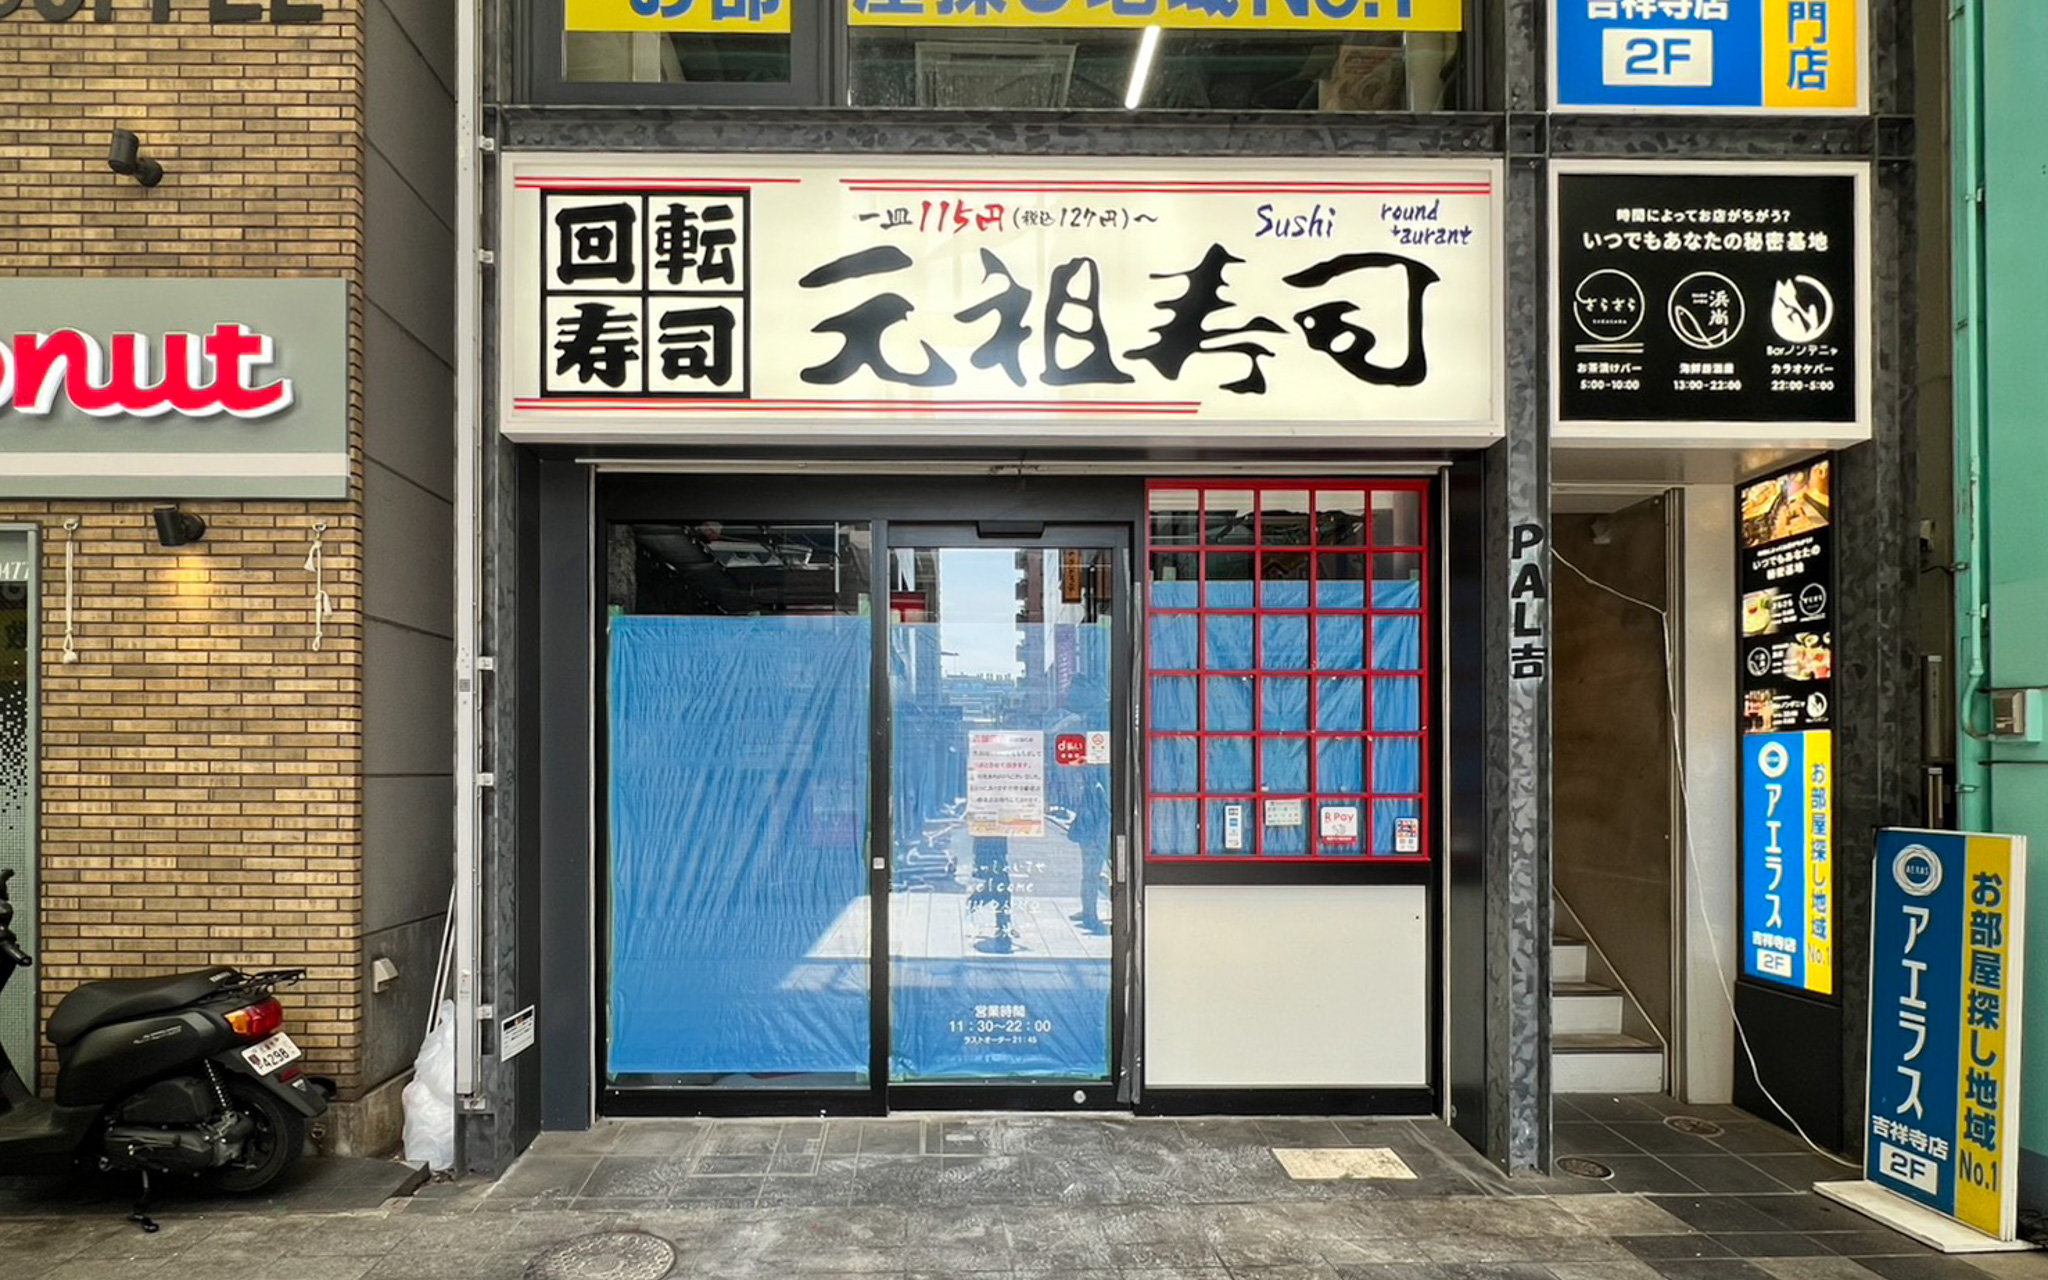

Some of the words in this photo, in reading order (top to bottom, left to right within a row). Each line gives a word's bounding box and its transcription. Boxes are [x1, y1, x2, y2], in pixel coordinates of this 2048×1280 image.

[1625, 37, 1692, 76] 2F
[1254, 203, 1337, 239] Sushi
[1380, 198, 1440, 222] round
[553, 201, 737, 286] 回転
[1582, 230, 1829, 252] いつでもあなたの秘密基地
[798, 242, 1442, 396] 元祖寿司
[553, 301, 737, 389] 寿司
[1770, 363, 1835, 376] カラオケバー
[1333, 812, 1355, 822] Pay
[1763, 783, 1784, 929] アエラス
[965, 878, 1034, 893] elcome
[1763, 953, 1786, 971] 2F
[974, 1004, 1027, 1019] 営業時間
[1895, 904, 1931, 1121] アエラス
[1963, 871, 2004, 1152] お部屋探し地域
[1871, 1114, 1949, 1162] 吉祥寺店
[1889, 1151, 1927, 1180] 2F
[1958, 1149, 1999, 1193] No.1
